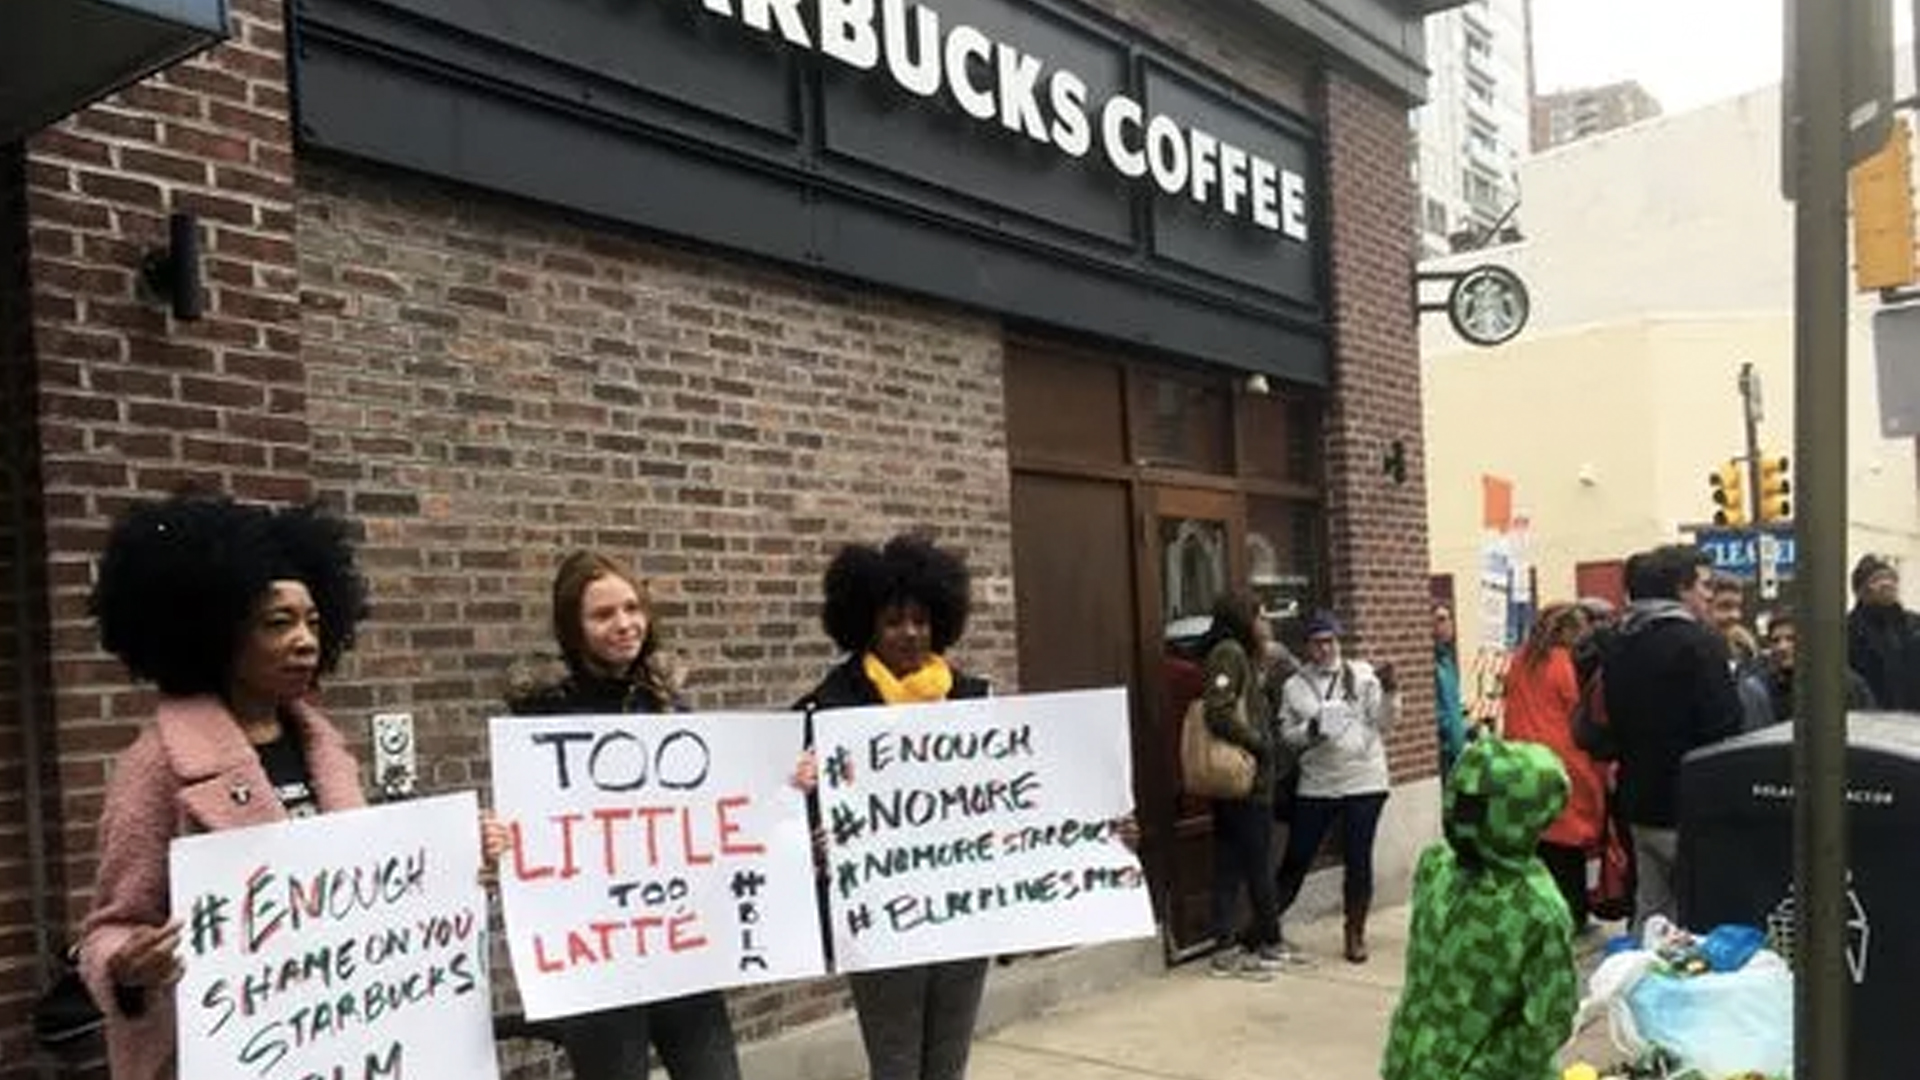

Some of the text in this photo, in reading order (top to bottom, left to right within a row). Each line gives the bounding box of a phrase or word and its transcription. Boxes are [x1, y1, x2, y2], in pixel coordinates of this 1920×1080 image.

[703, 0, 1306, 241] BUCKS COFFEE
[532, 729, 709, 791] TOO
[510, 797, 766, 881] LITTLE
[609, 878, 688, 906] TOO
[202, 908, 474, 1036] SHAME ON YOU
